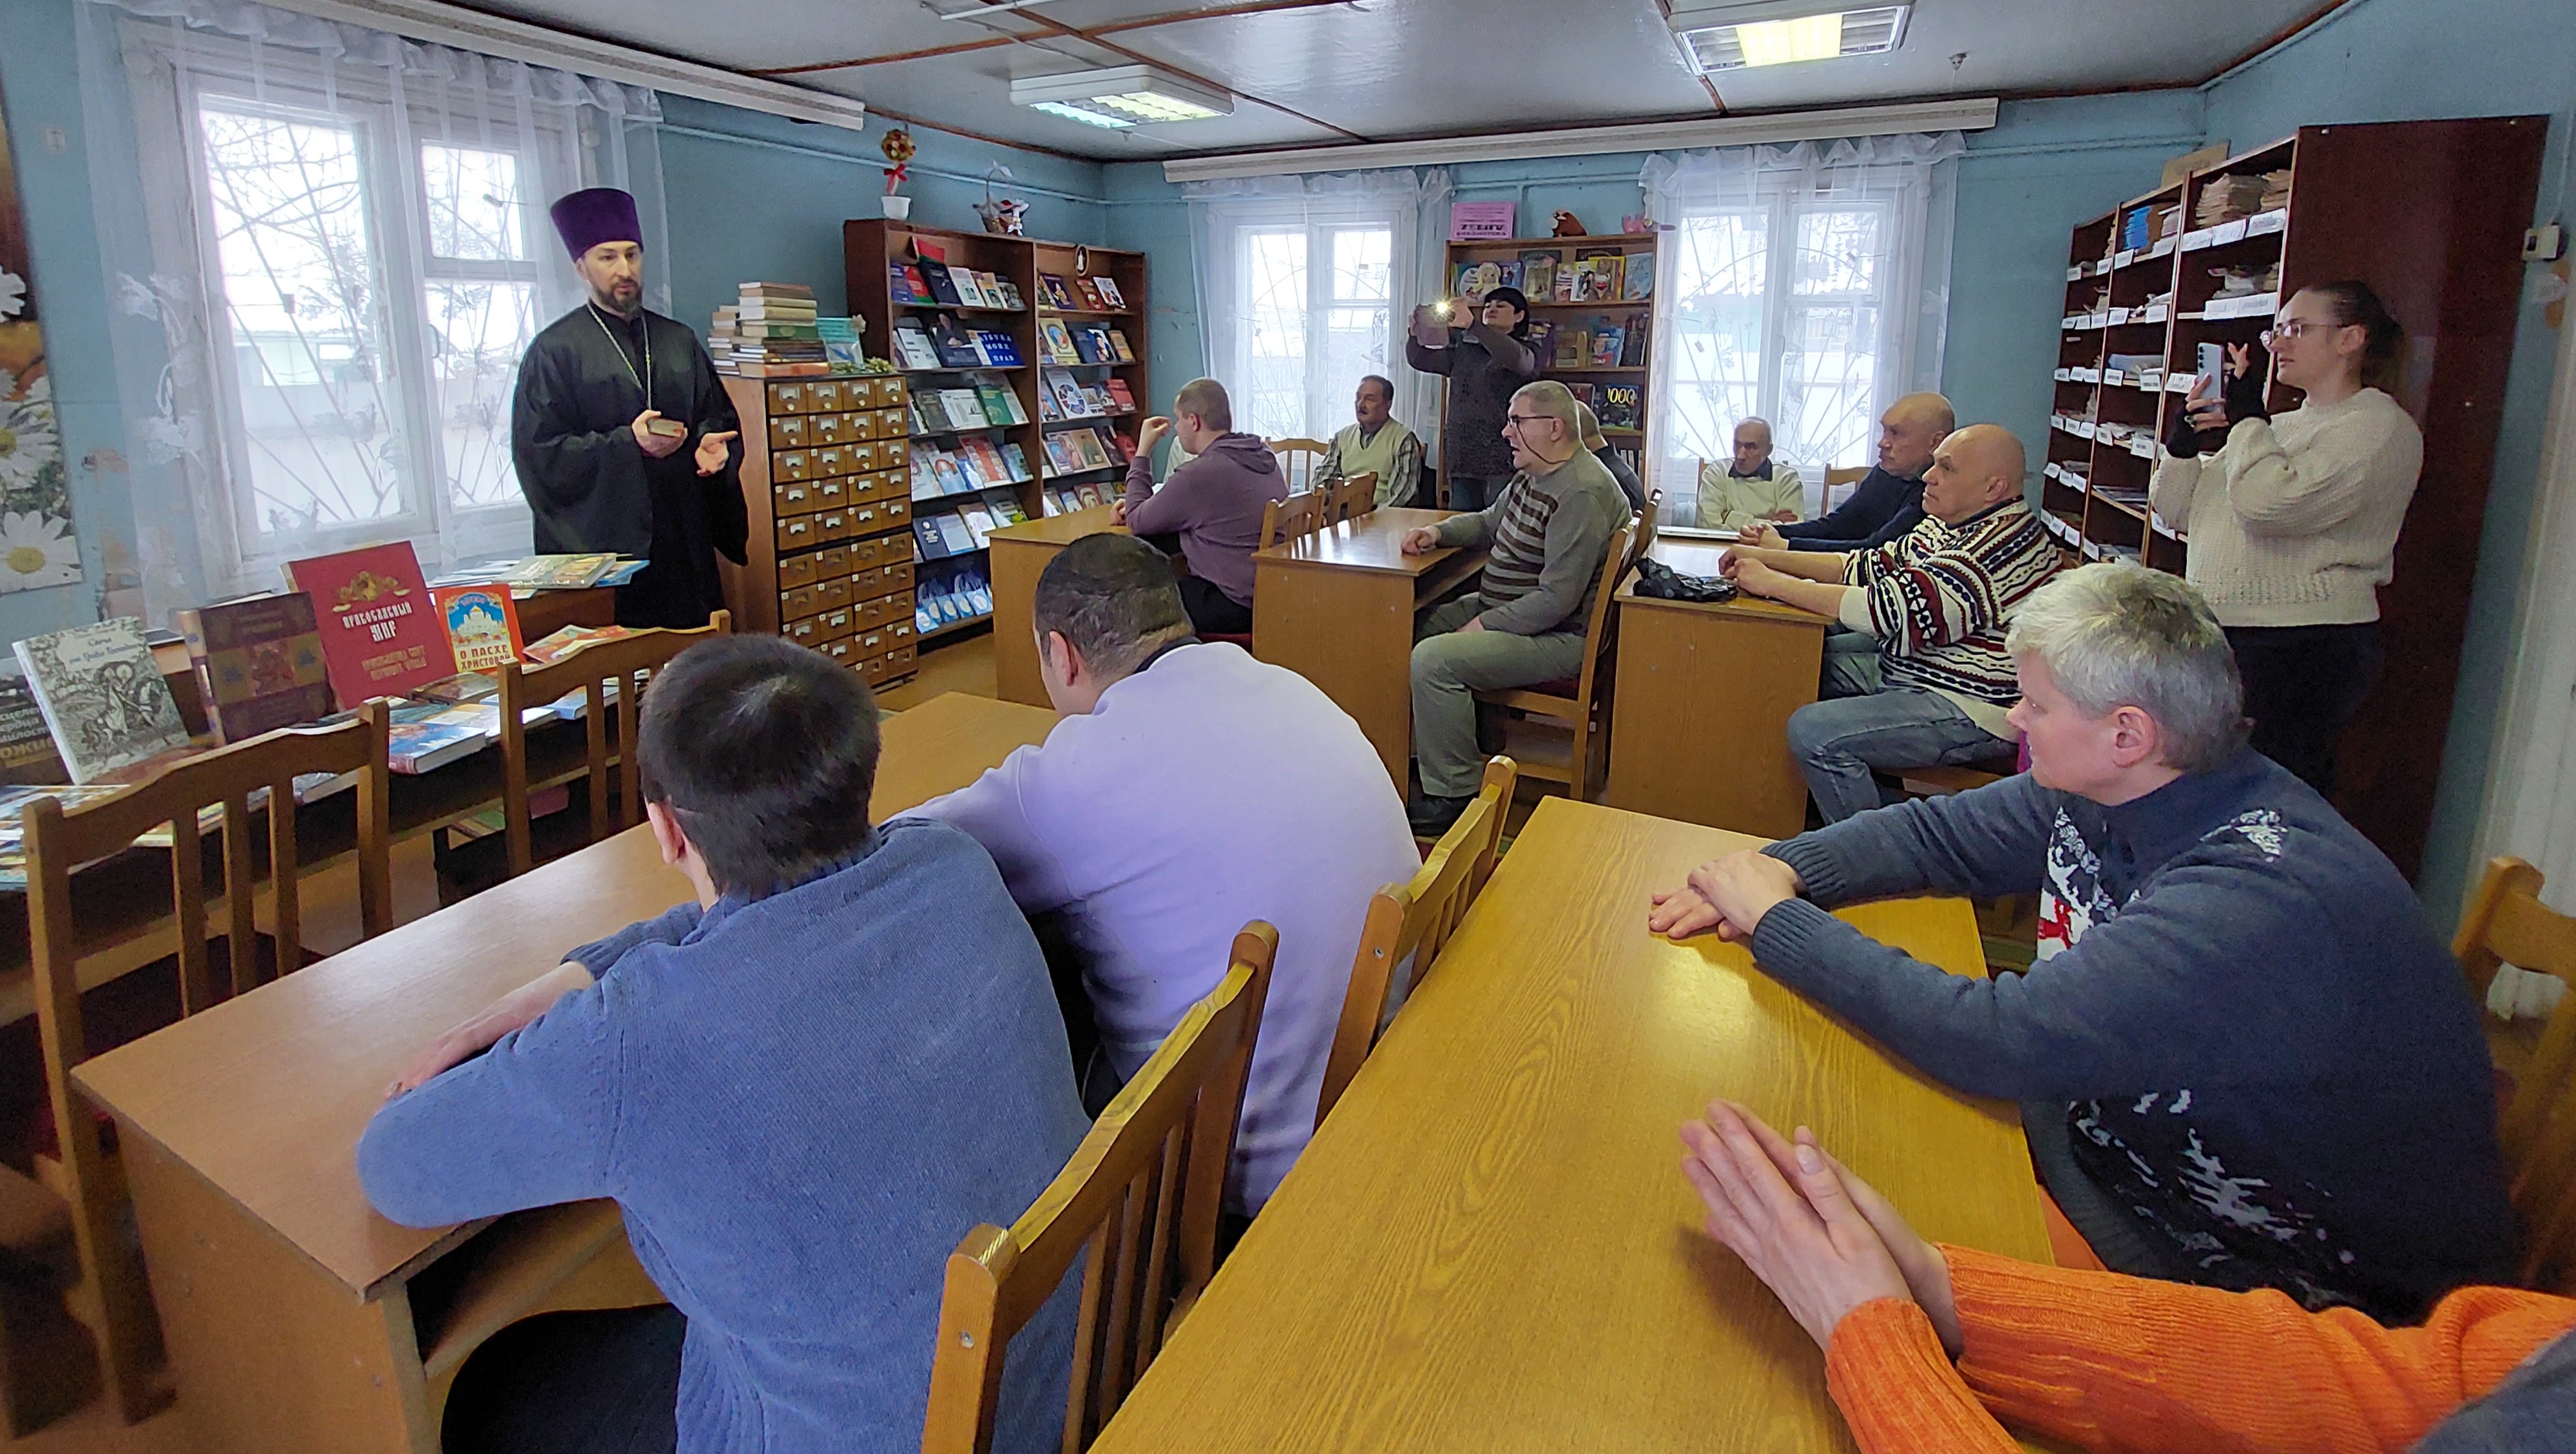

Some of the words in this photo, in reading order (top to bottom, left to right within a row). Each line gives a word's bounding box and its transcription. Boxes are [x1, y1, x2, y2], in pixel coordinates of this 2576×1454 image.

[342, 601, 412, 629] ПРАВОСЛАВНЫЙ
[369, 620, 396, 642] МИР
[459, 650, 467, 660] О
[471, 645, 508, 658] ПАСХЕ
[0, 717, 39, 732] ердца
